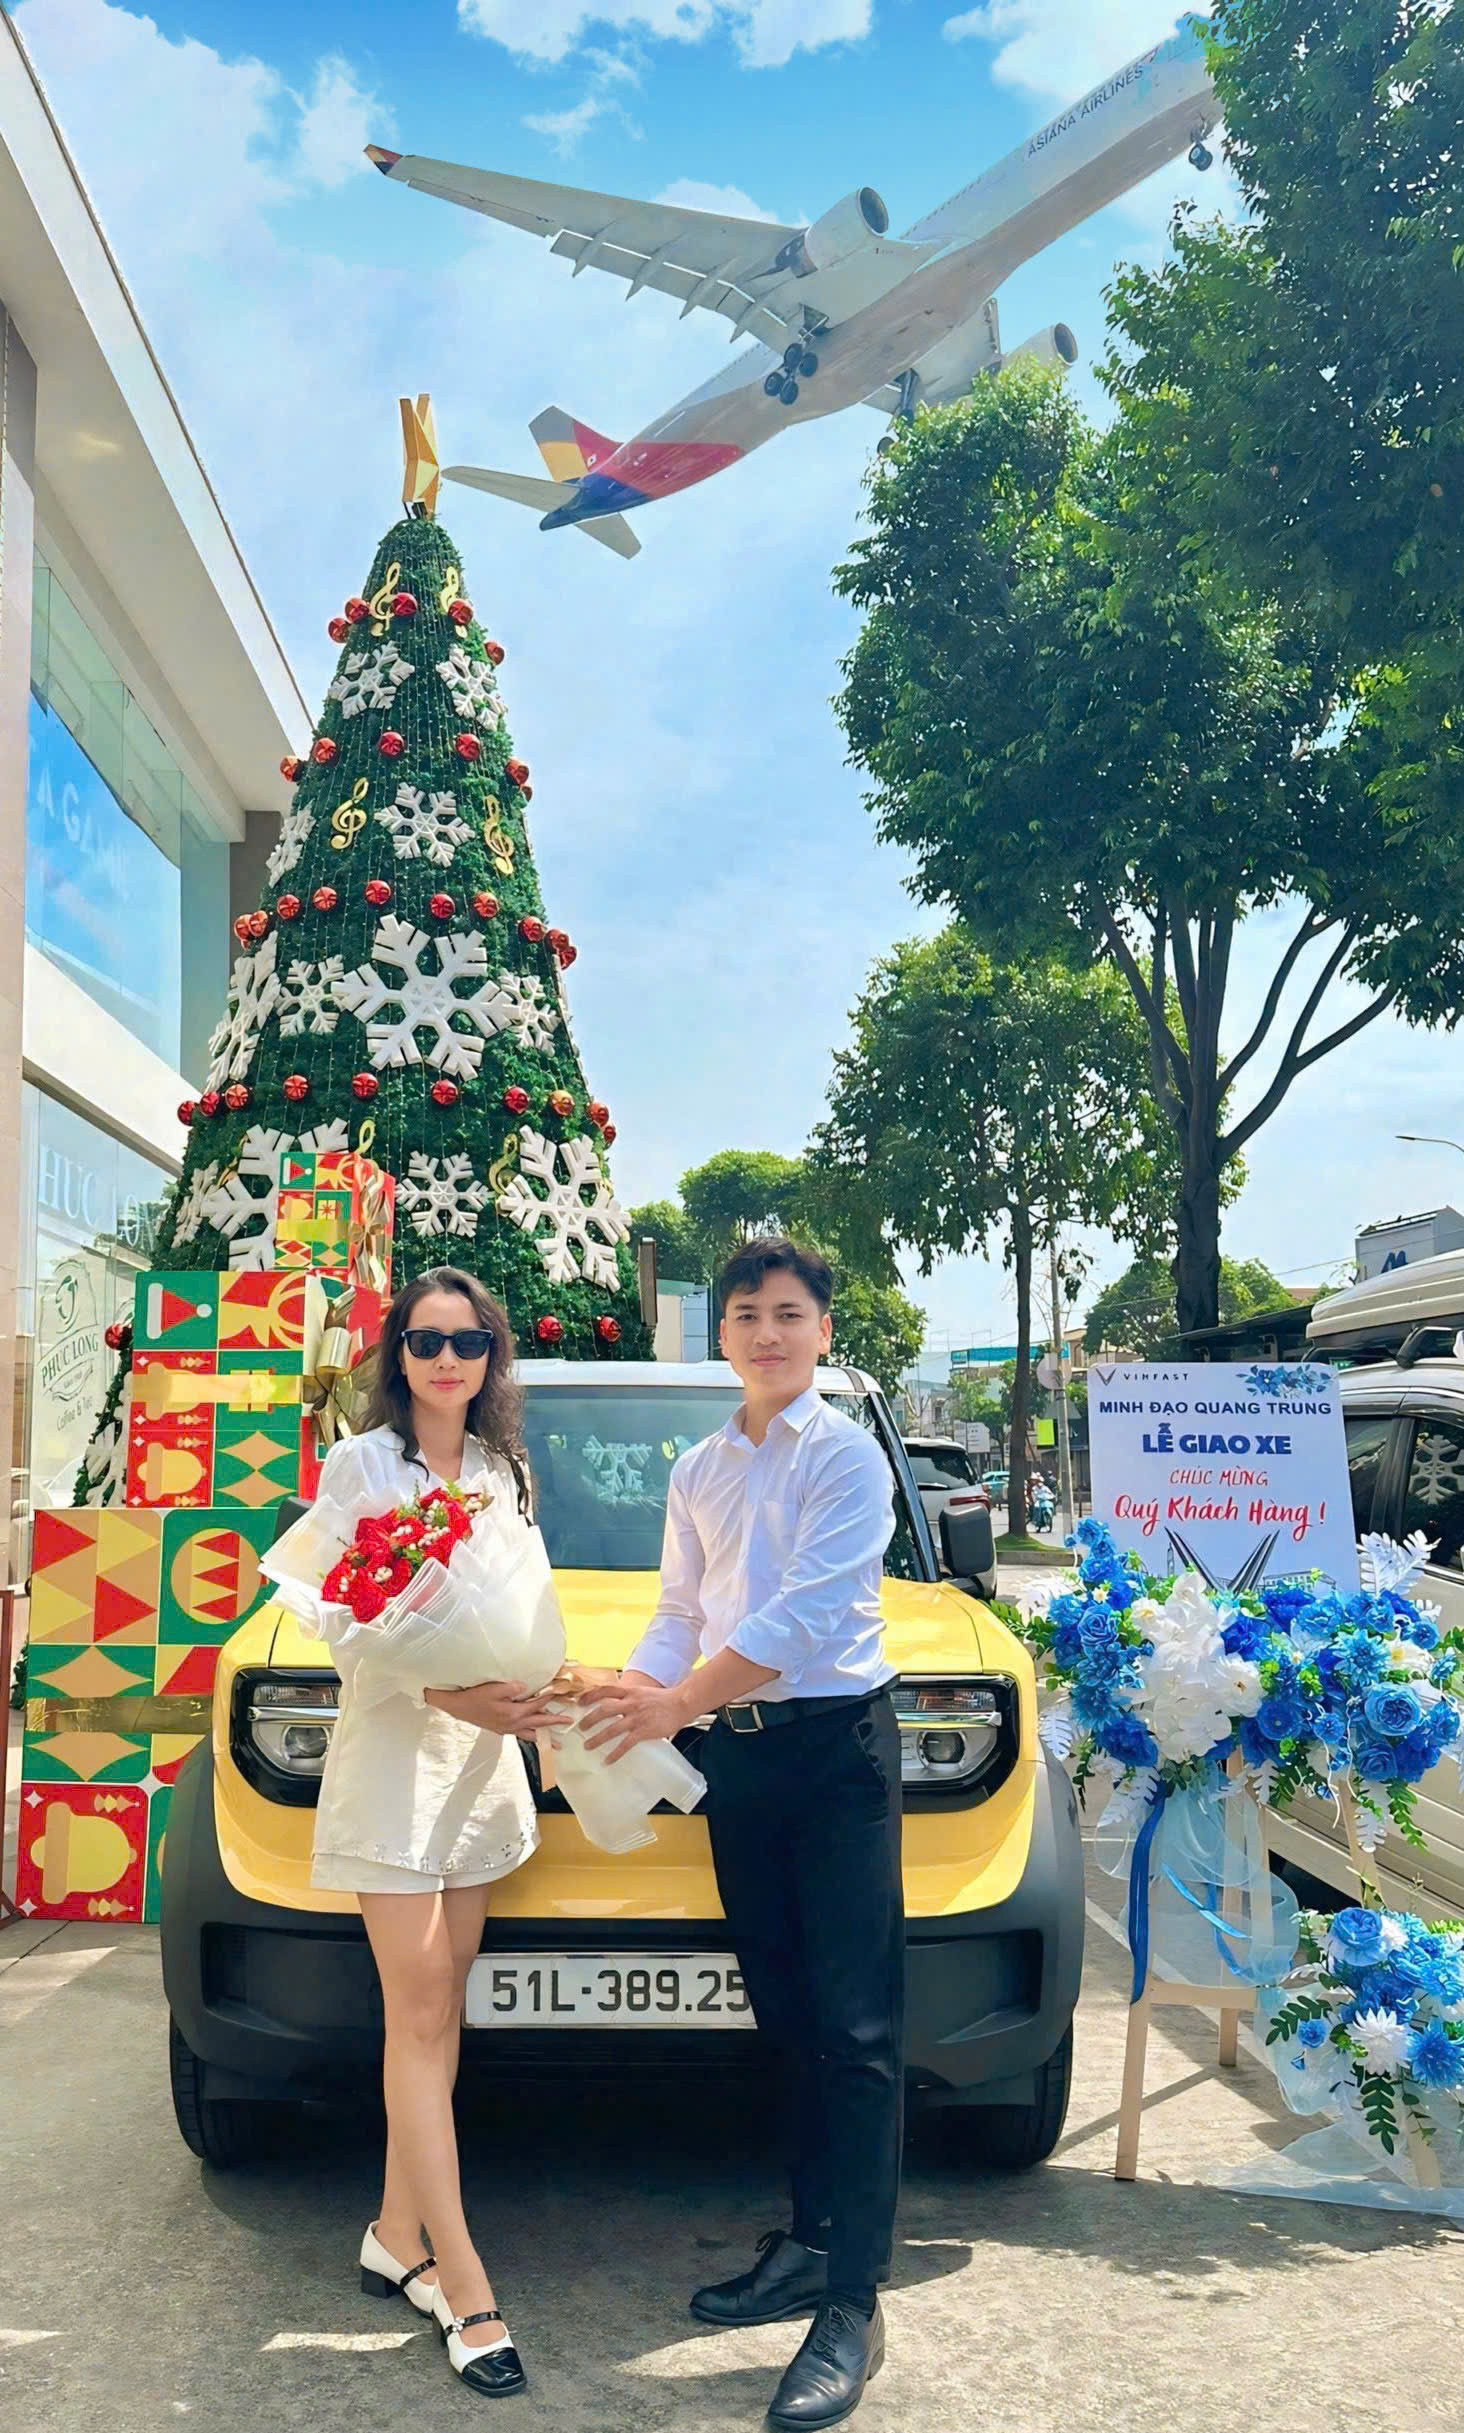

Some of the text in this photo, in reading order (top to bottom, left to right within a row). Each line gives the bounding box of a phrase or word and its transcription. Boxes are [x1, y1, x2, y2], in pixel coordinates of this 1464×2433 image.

[1027, 65, 1144, 158] ASIANA AIRLINES
[1100, 1401, 1332, 1416] MINH ĐẠO QUANG TRUNG
[1142, 1422, 1292, 1455] LỄ GIAO XE
[1169, 1465, 1213, 1486] CHÚC
[1114, 1494, 1161, 1537] Quý
[1167, 1495, 1239, 1522] Khách
[1248, 1499, 1314, 1542] Hàng
[492, 1969, 751, 2012] 51L-389.25
